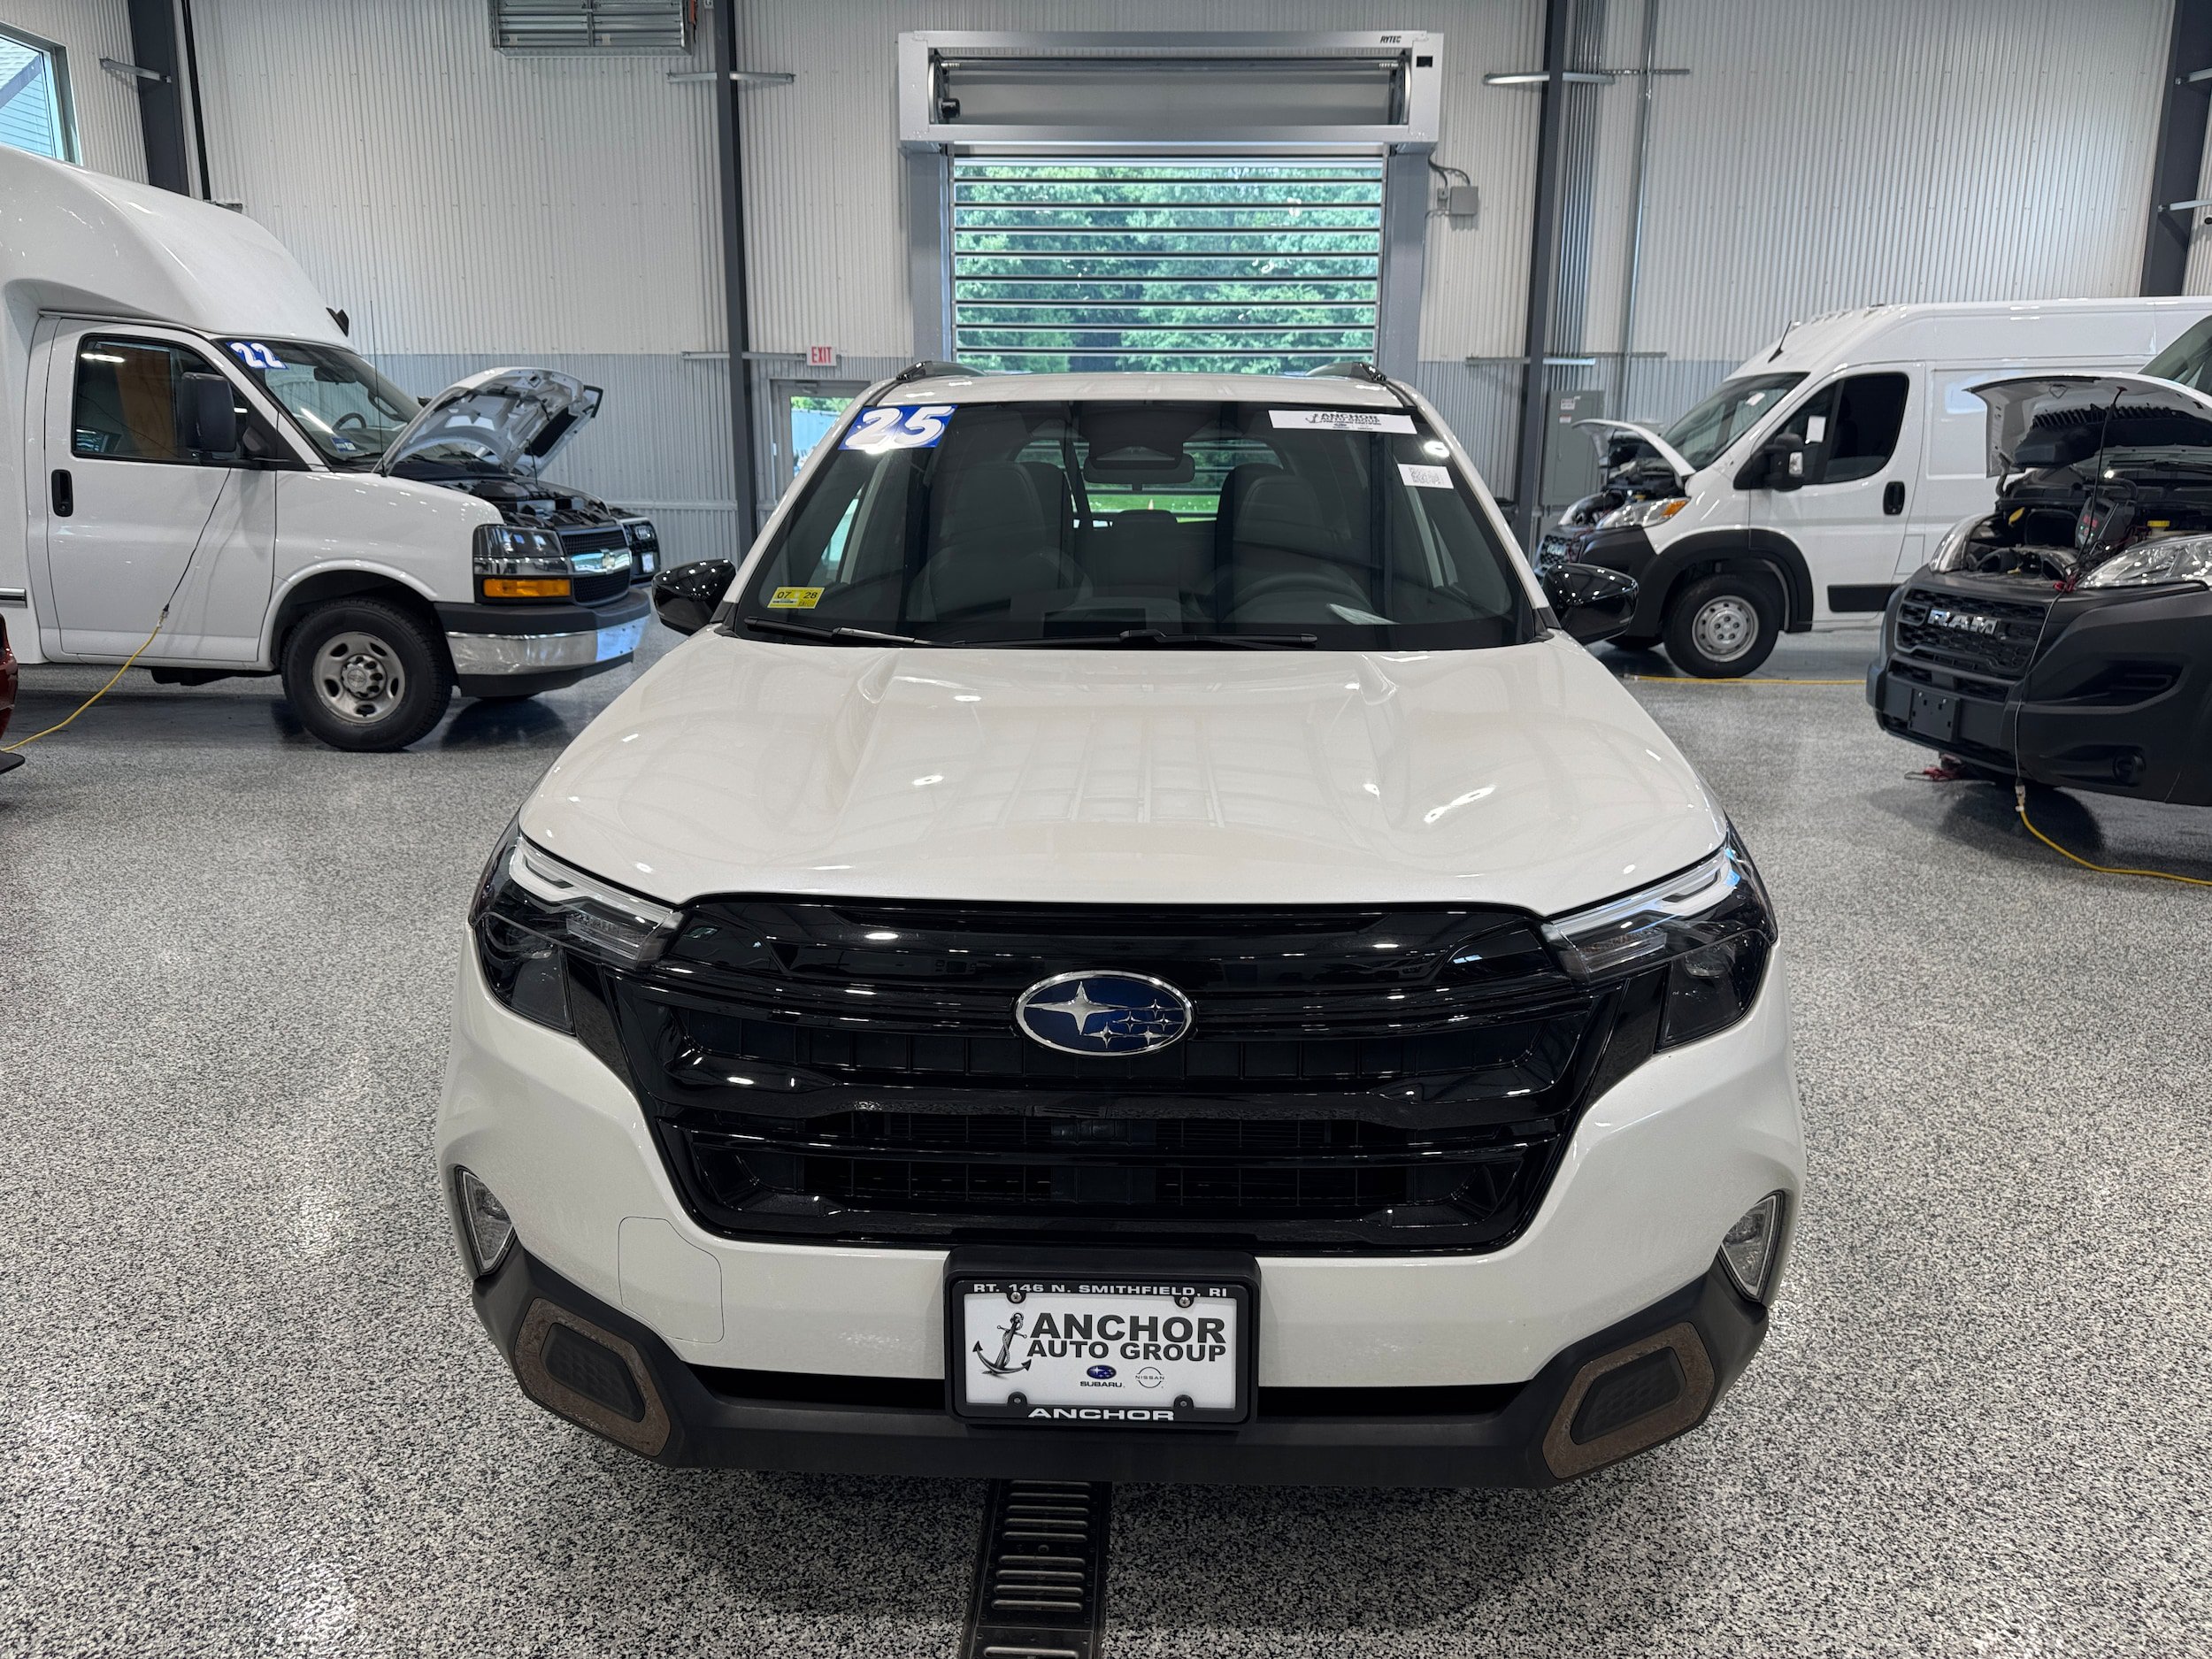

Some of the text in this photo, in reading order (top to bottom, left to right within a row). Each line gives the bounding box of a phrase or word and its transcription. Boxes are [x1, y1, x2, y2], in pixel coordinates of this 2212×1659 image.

[231, 342, 287, 368] 22
[811, 346, 832, 364] EXIT
[845, 406, 955, 449] 25
[1927, 609, 1998, 635] RAM
[973, 1284, 1000, 1293] RT.
[1009, 1284, 1044, 1293] 146
[1079, 1285, 1202, 1297] SMITHFIELD,
[1209, 1287, 1227, 1296] RI
[1030, 1313, 1226, 1343] ANCHOR
[1026, 1340, 1226, 1362] AUTO GROUP
[1028, 1409, 1174, 1421] ANCHOR
